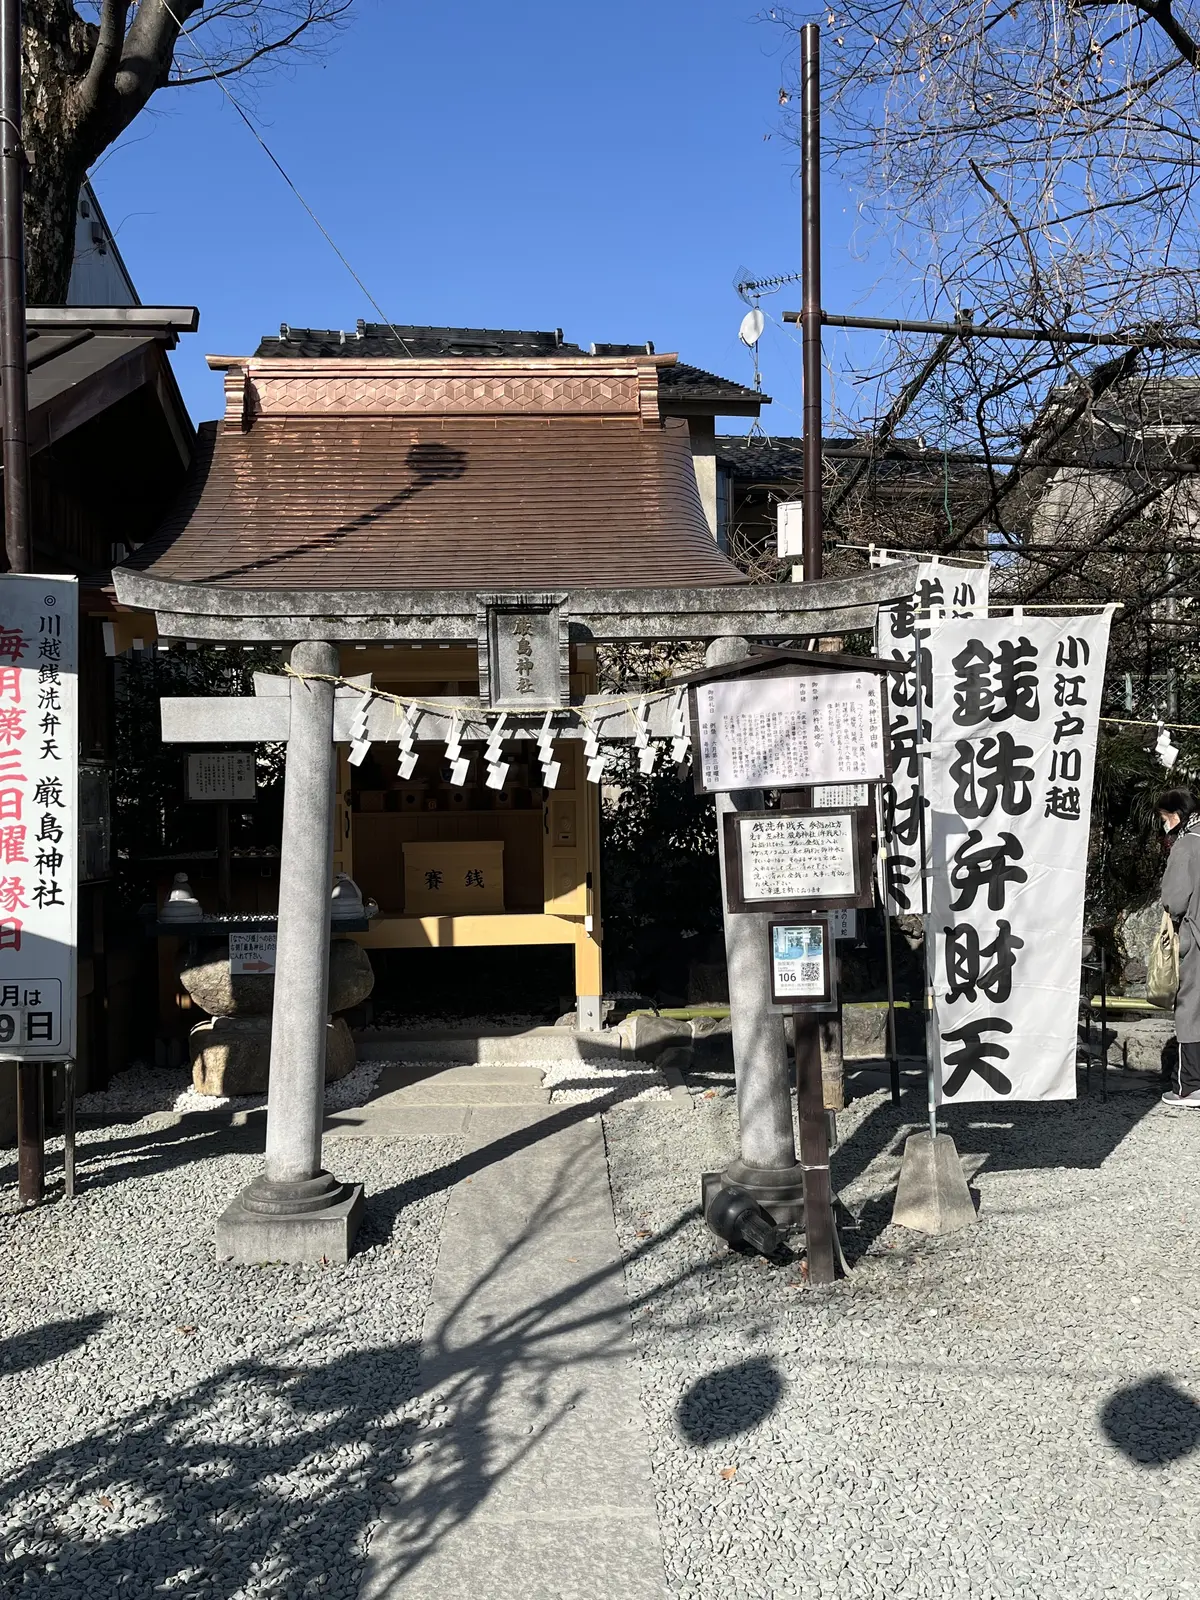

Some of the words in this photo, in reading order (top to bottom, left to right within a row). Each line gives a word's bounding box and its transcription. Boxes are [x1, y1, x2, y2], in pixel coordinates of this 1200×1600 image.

[952, 583, 976, 618] 小
[37, 614, 62, 761] 川越銭洗弁天
[1045, 635, 1090, 820] 小江戸川越
[32, 776, 66, 909] 厳島神社
[941, 636, 1040, 1096] 銭洗弁財天
[27, 1012, 53, 1041] 日
[778, 972, 797, 982] 106
